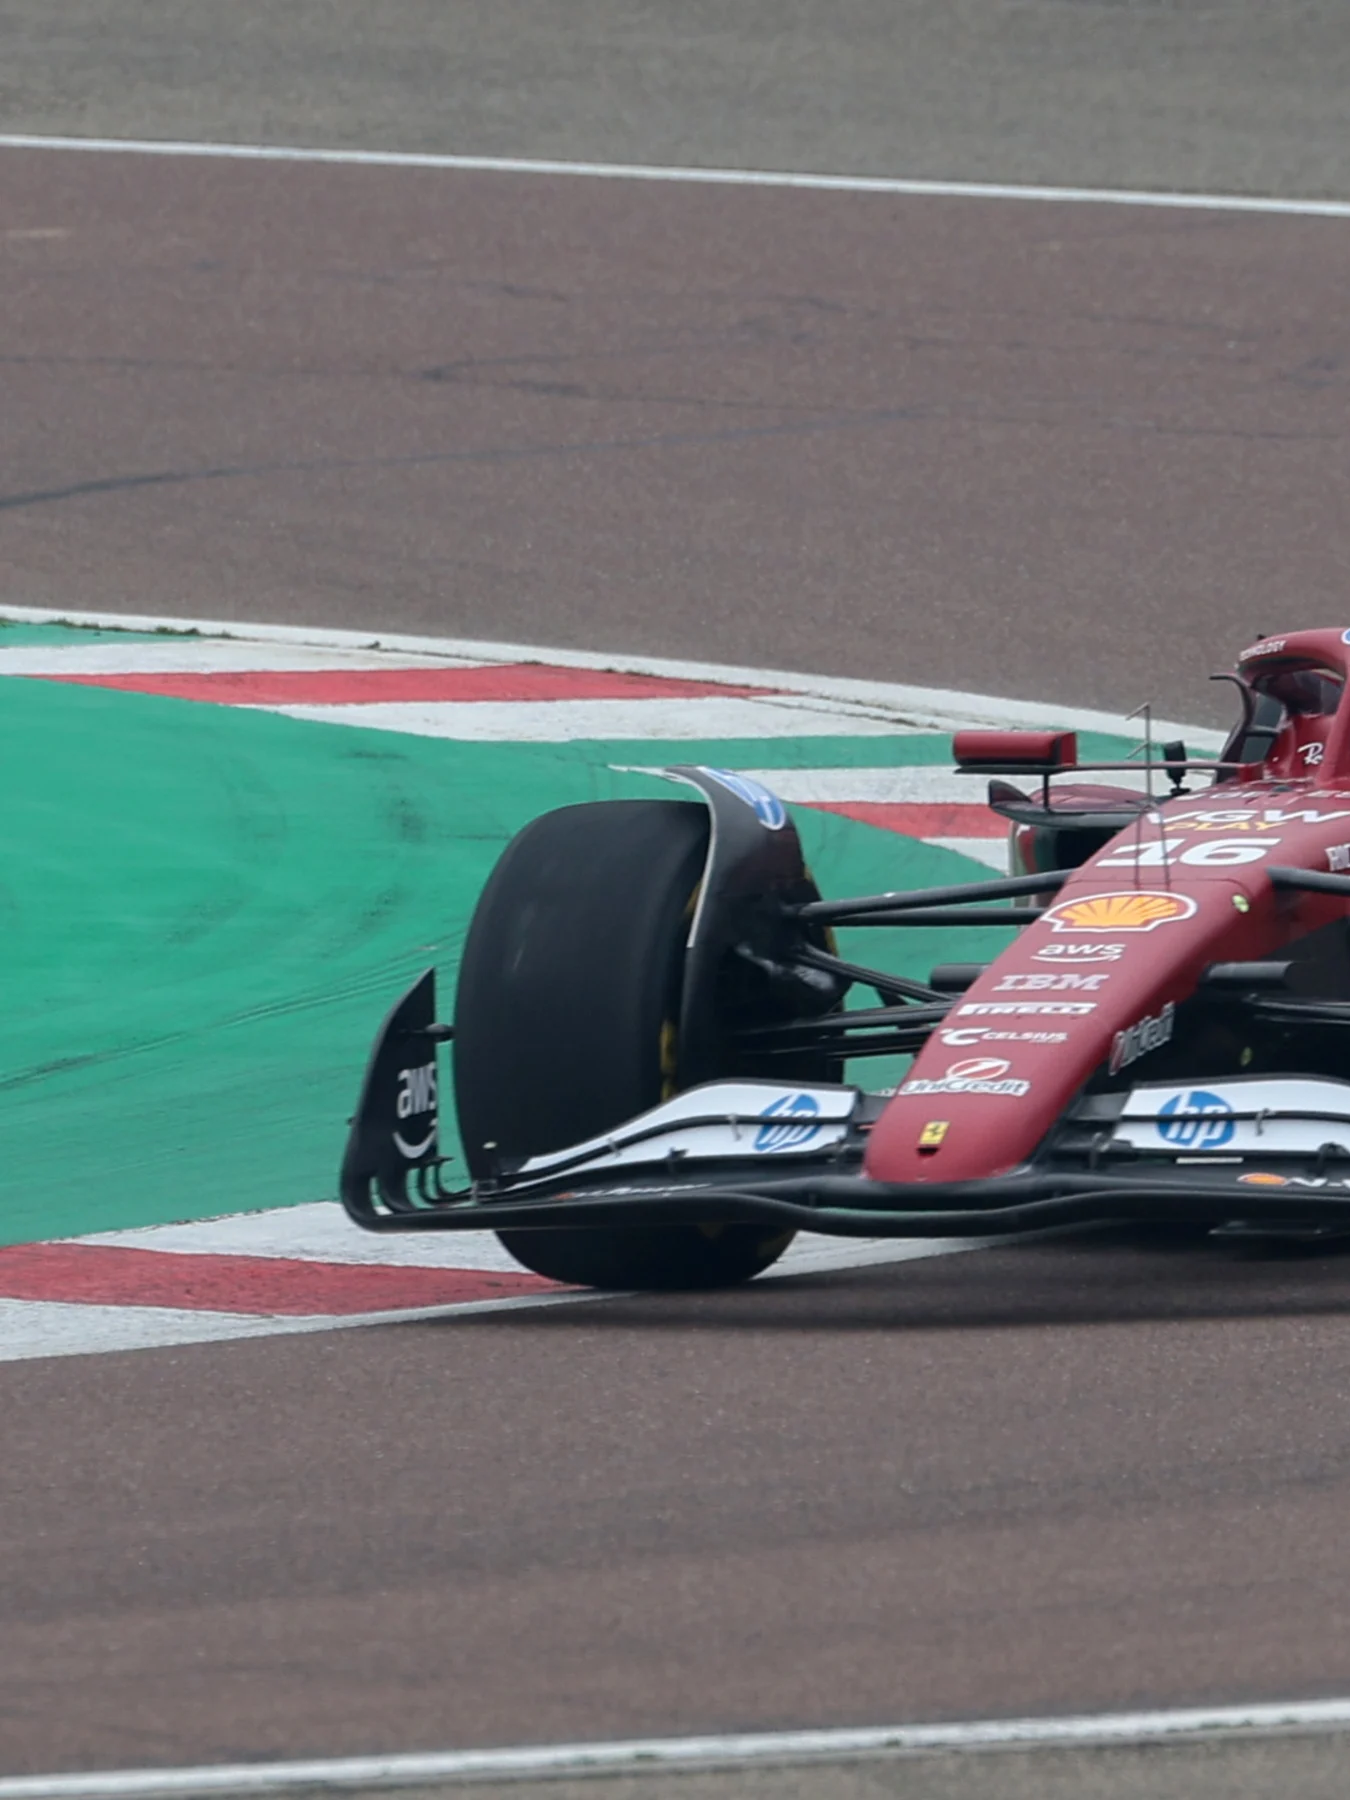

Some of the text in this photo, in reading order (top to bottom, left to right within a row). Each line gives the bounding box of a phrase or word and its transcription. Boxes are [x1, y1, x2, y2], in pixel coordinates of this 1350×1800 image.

[1163, 821, 1288, 831] PLAY
[1097, 838, 1281, 867] 16
[1038, 943, 1126, 955] aws
[991, 974, 1110, 991] IBM
[956, 1003, 1098, 1015] PIRELLI
[981, 1032, 1068, 1041] CELSIUS
[900, 1079, 1030, 1096] UniCredit
[757, 1093, 818, 1152] hp
[1165, 1090, 1228, 1148] hp
